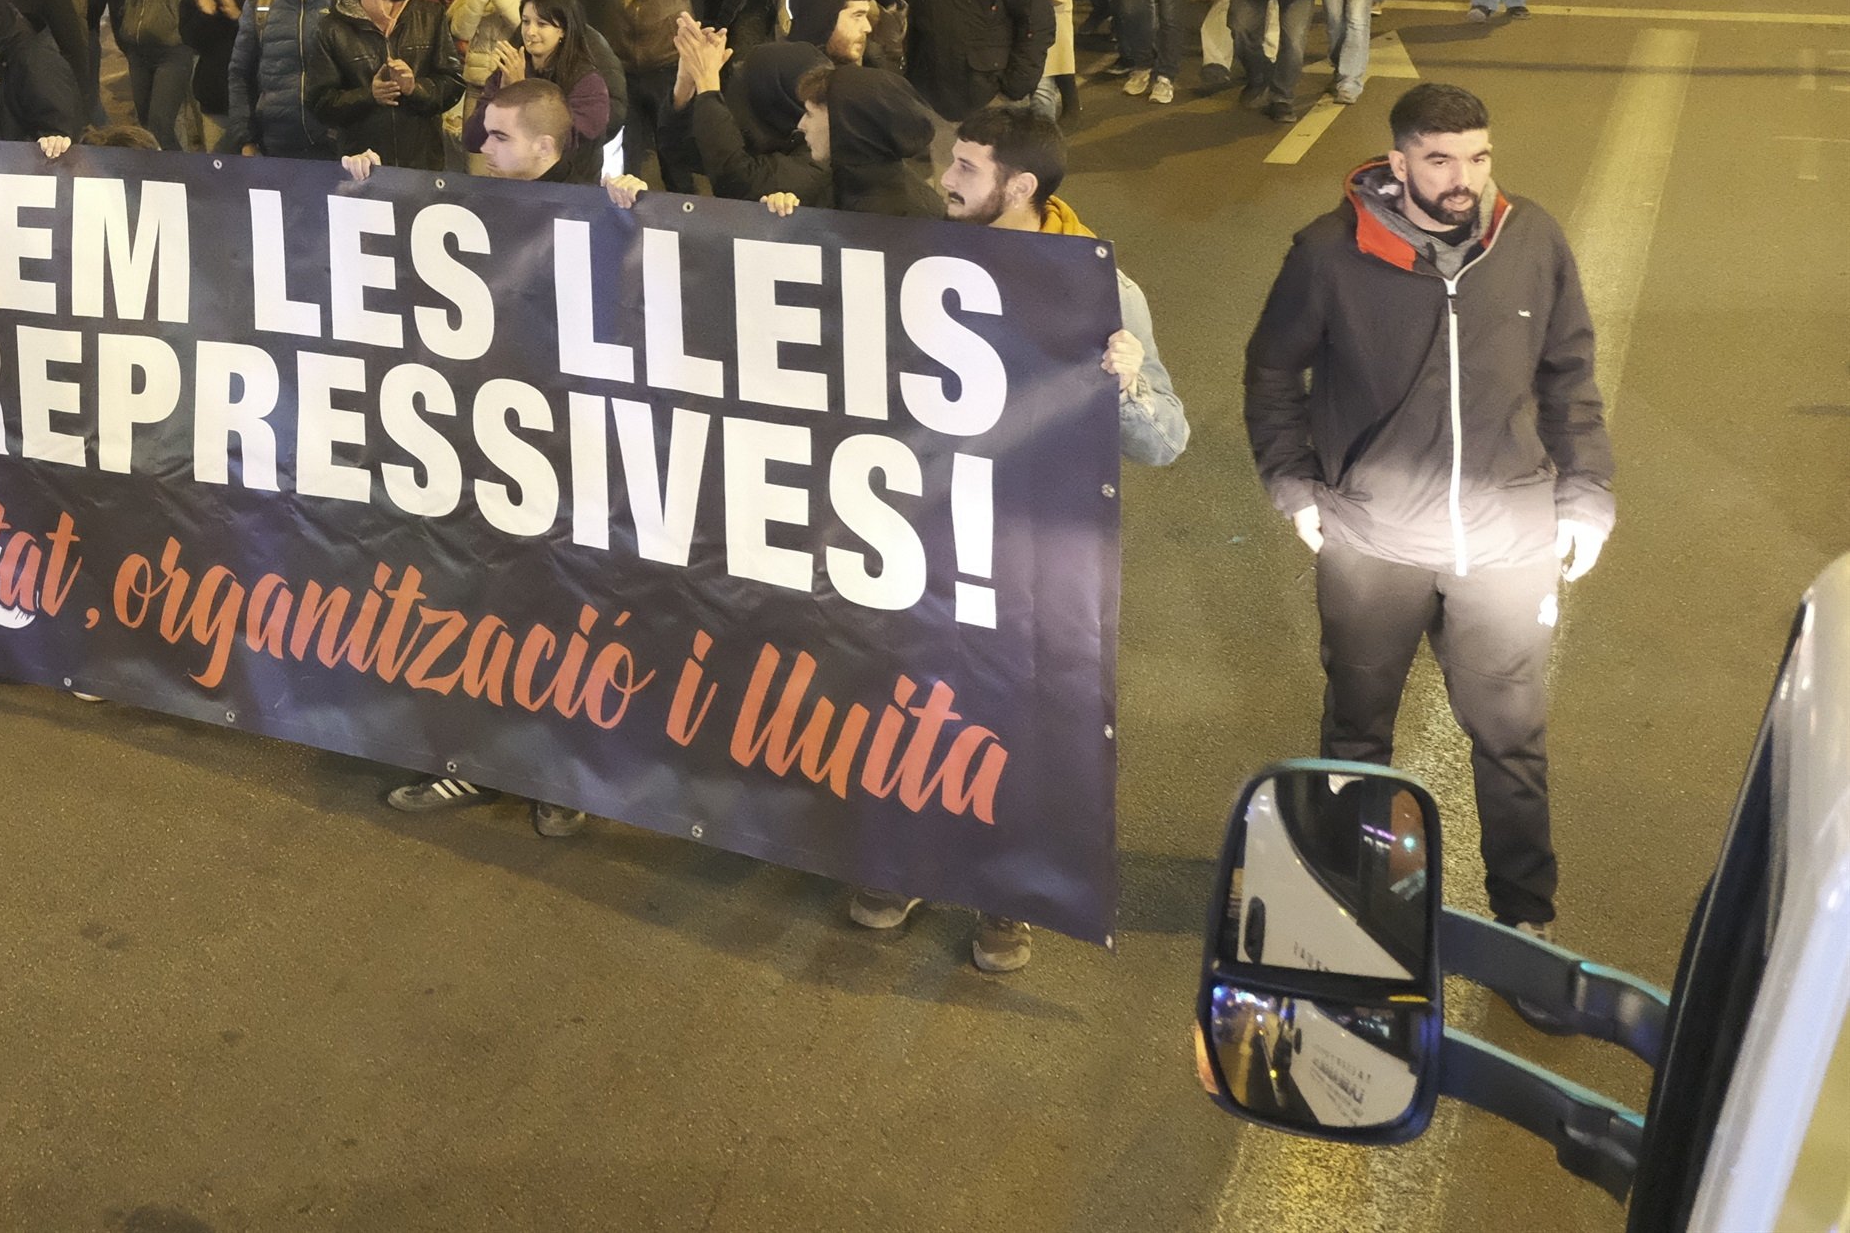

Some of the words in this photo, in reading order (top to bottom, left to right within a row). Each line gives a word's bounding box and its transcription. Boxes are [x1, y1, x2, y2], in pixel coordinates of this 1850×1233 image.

[248, 188, 496, 361] LES
[553, 218, 1008, 437] LLEIS
[111, 535, 656, 731] organització
[665, 629, 719, 747] i
[729, 642, 1009, 826] lluita
